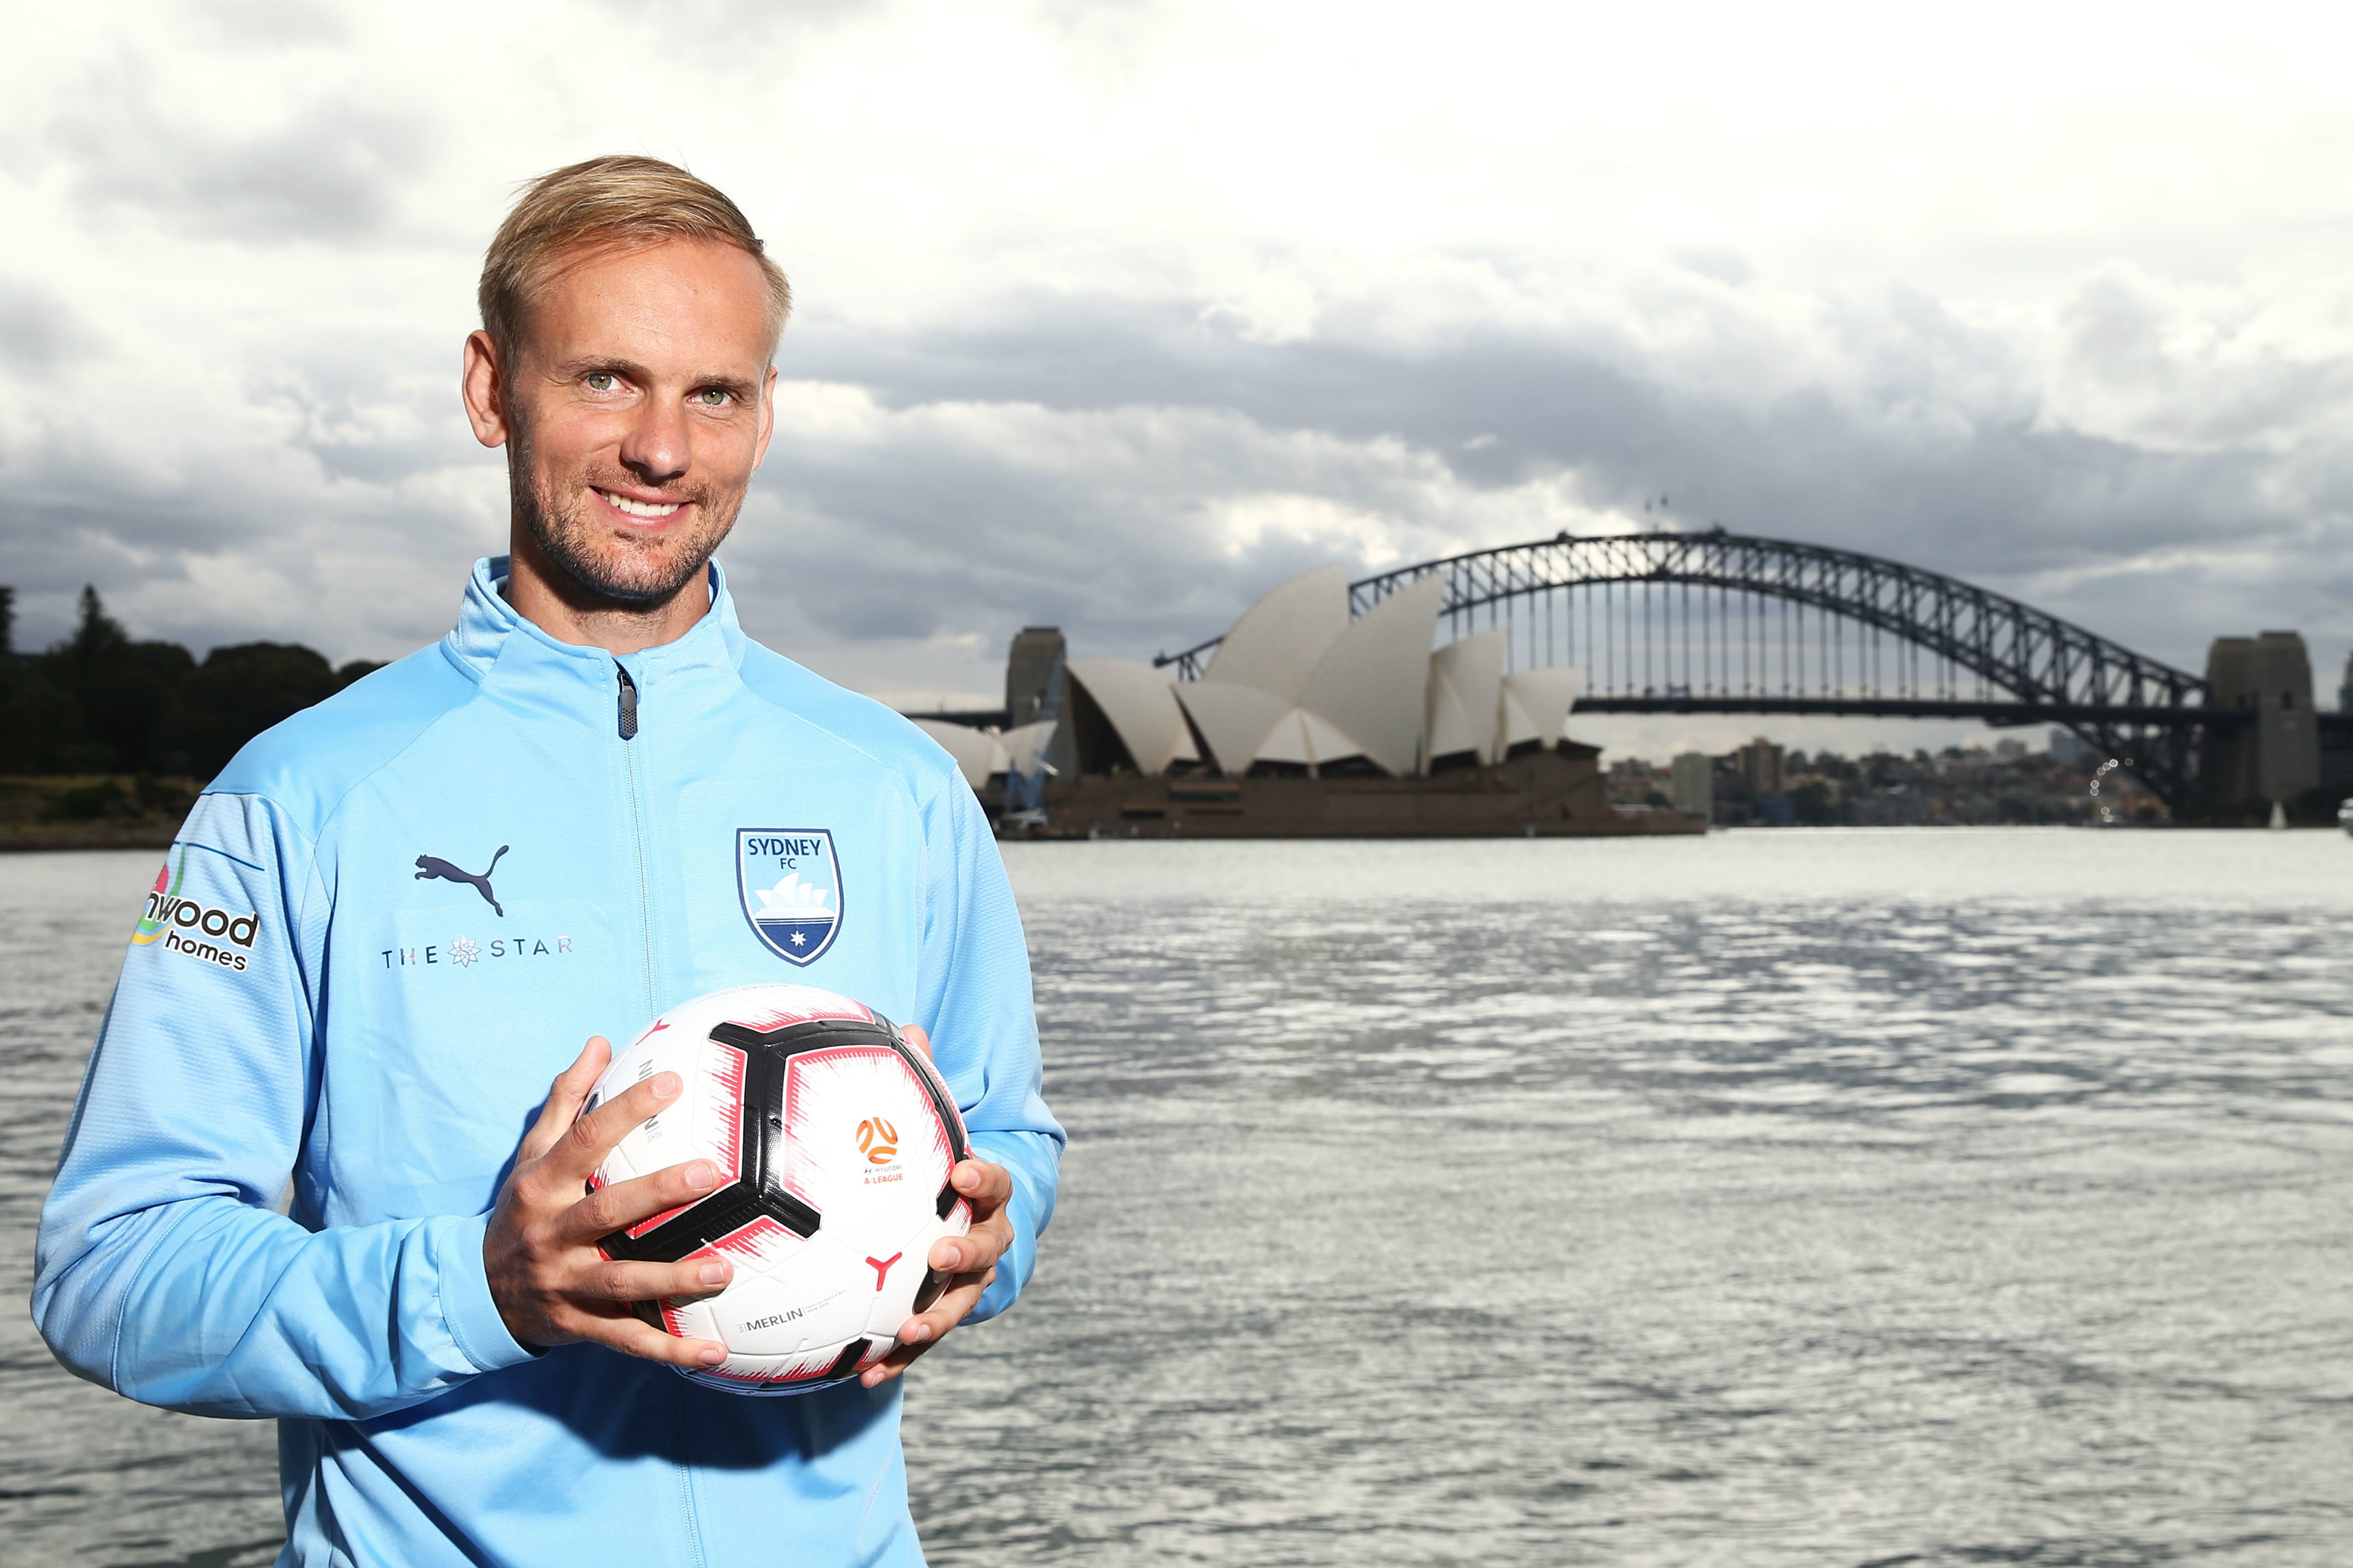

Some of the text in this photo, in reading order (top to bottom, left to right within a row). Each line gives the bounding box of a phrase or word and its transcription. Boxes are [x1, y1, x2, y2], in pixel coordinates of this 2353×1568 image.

[748, 838, 821, 856] SYDNEY
[780, 858, 797, 870] FC
[165, 930, 247, 971] homes
[382, 935, 573, 969] THE STAR
[746, 1307, 803, 1332] MERLIN
